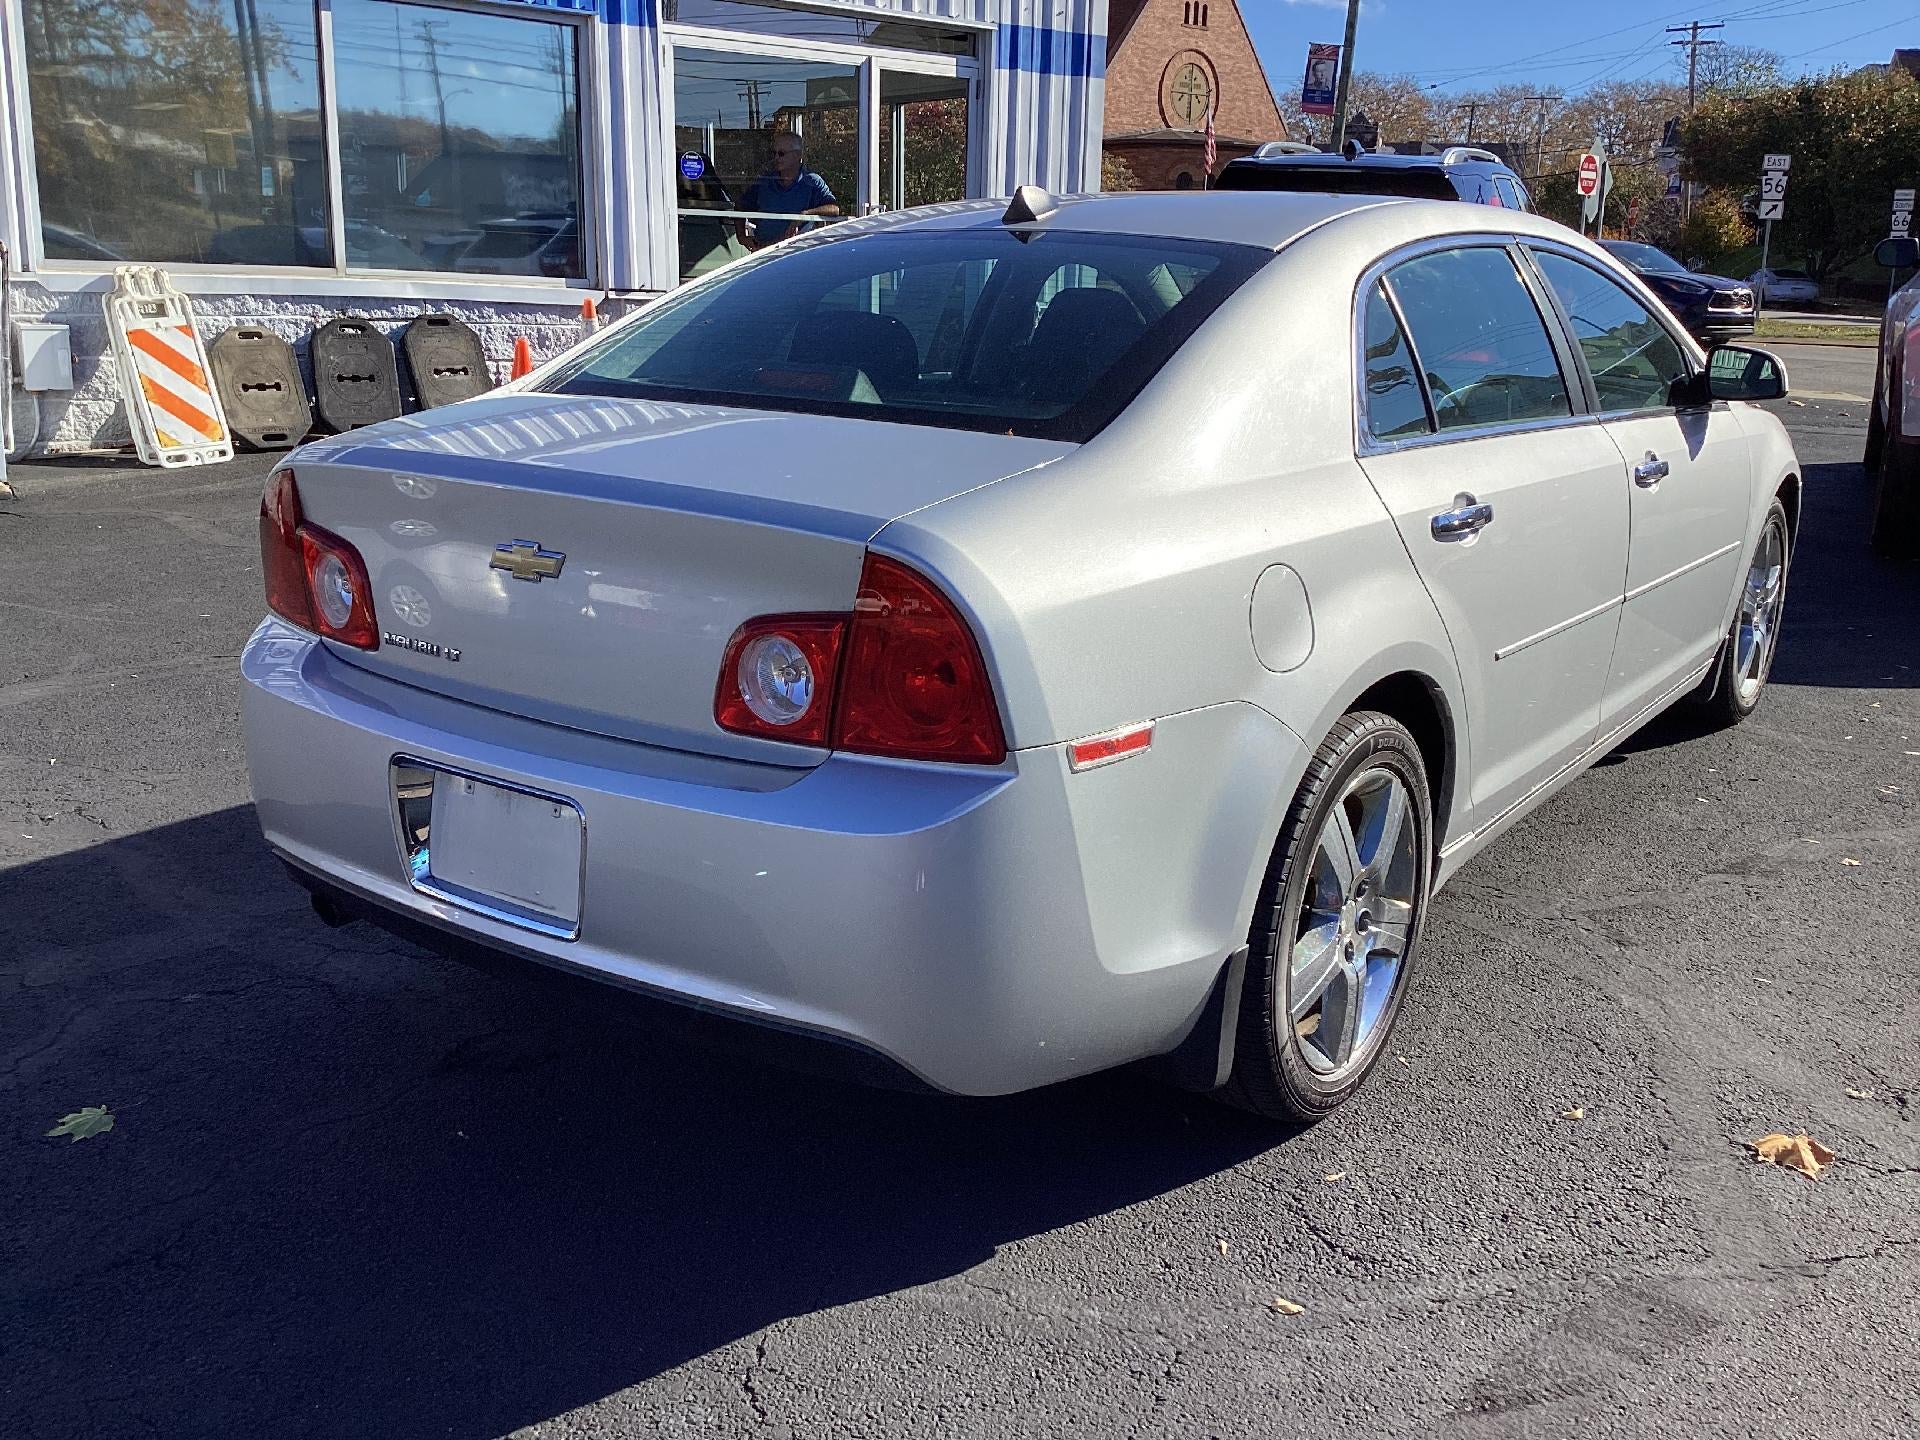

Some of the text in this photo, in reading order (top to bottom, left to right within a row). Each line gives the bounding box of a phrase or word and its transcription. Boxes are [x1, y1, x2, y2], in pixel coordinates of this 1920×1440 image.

[1766, 156, 1787, 167] EAST
[1763, 177, 1785, 194] 56
[1893, 215, 1909, 227] 66
